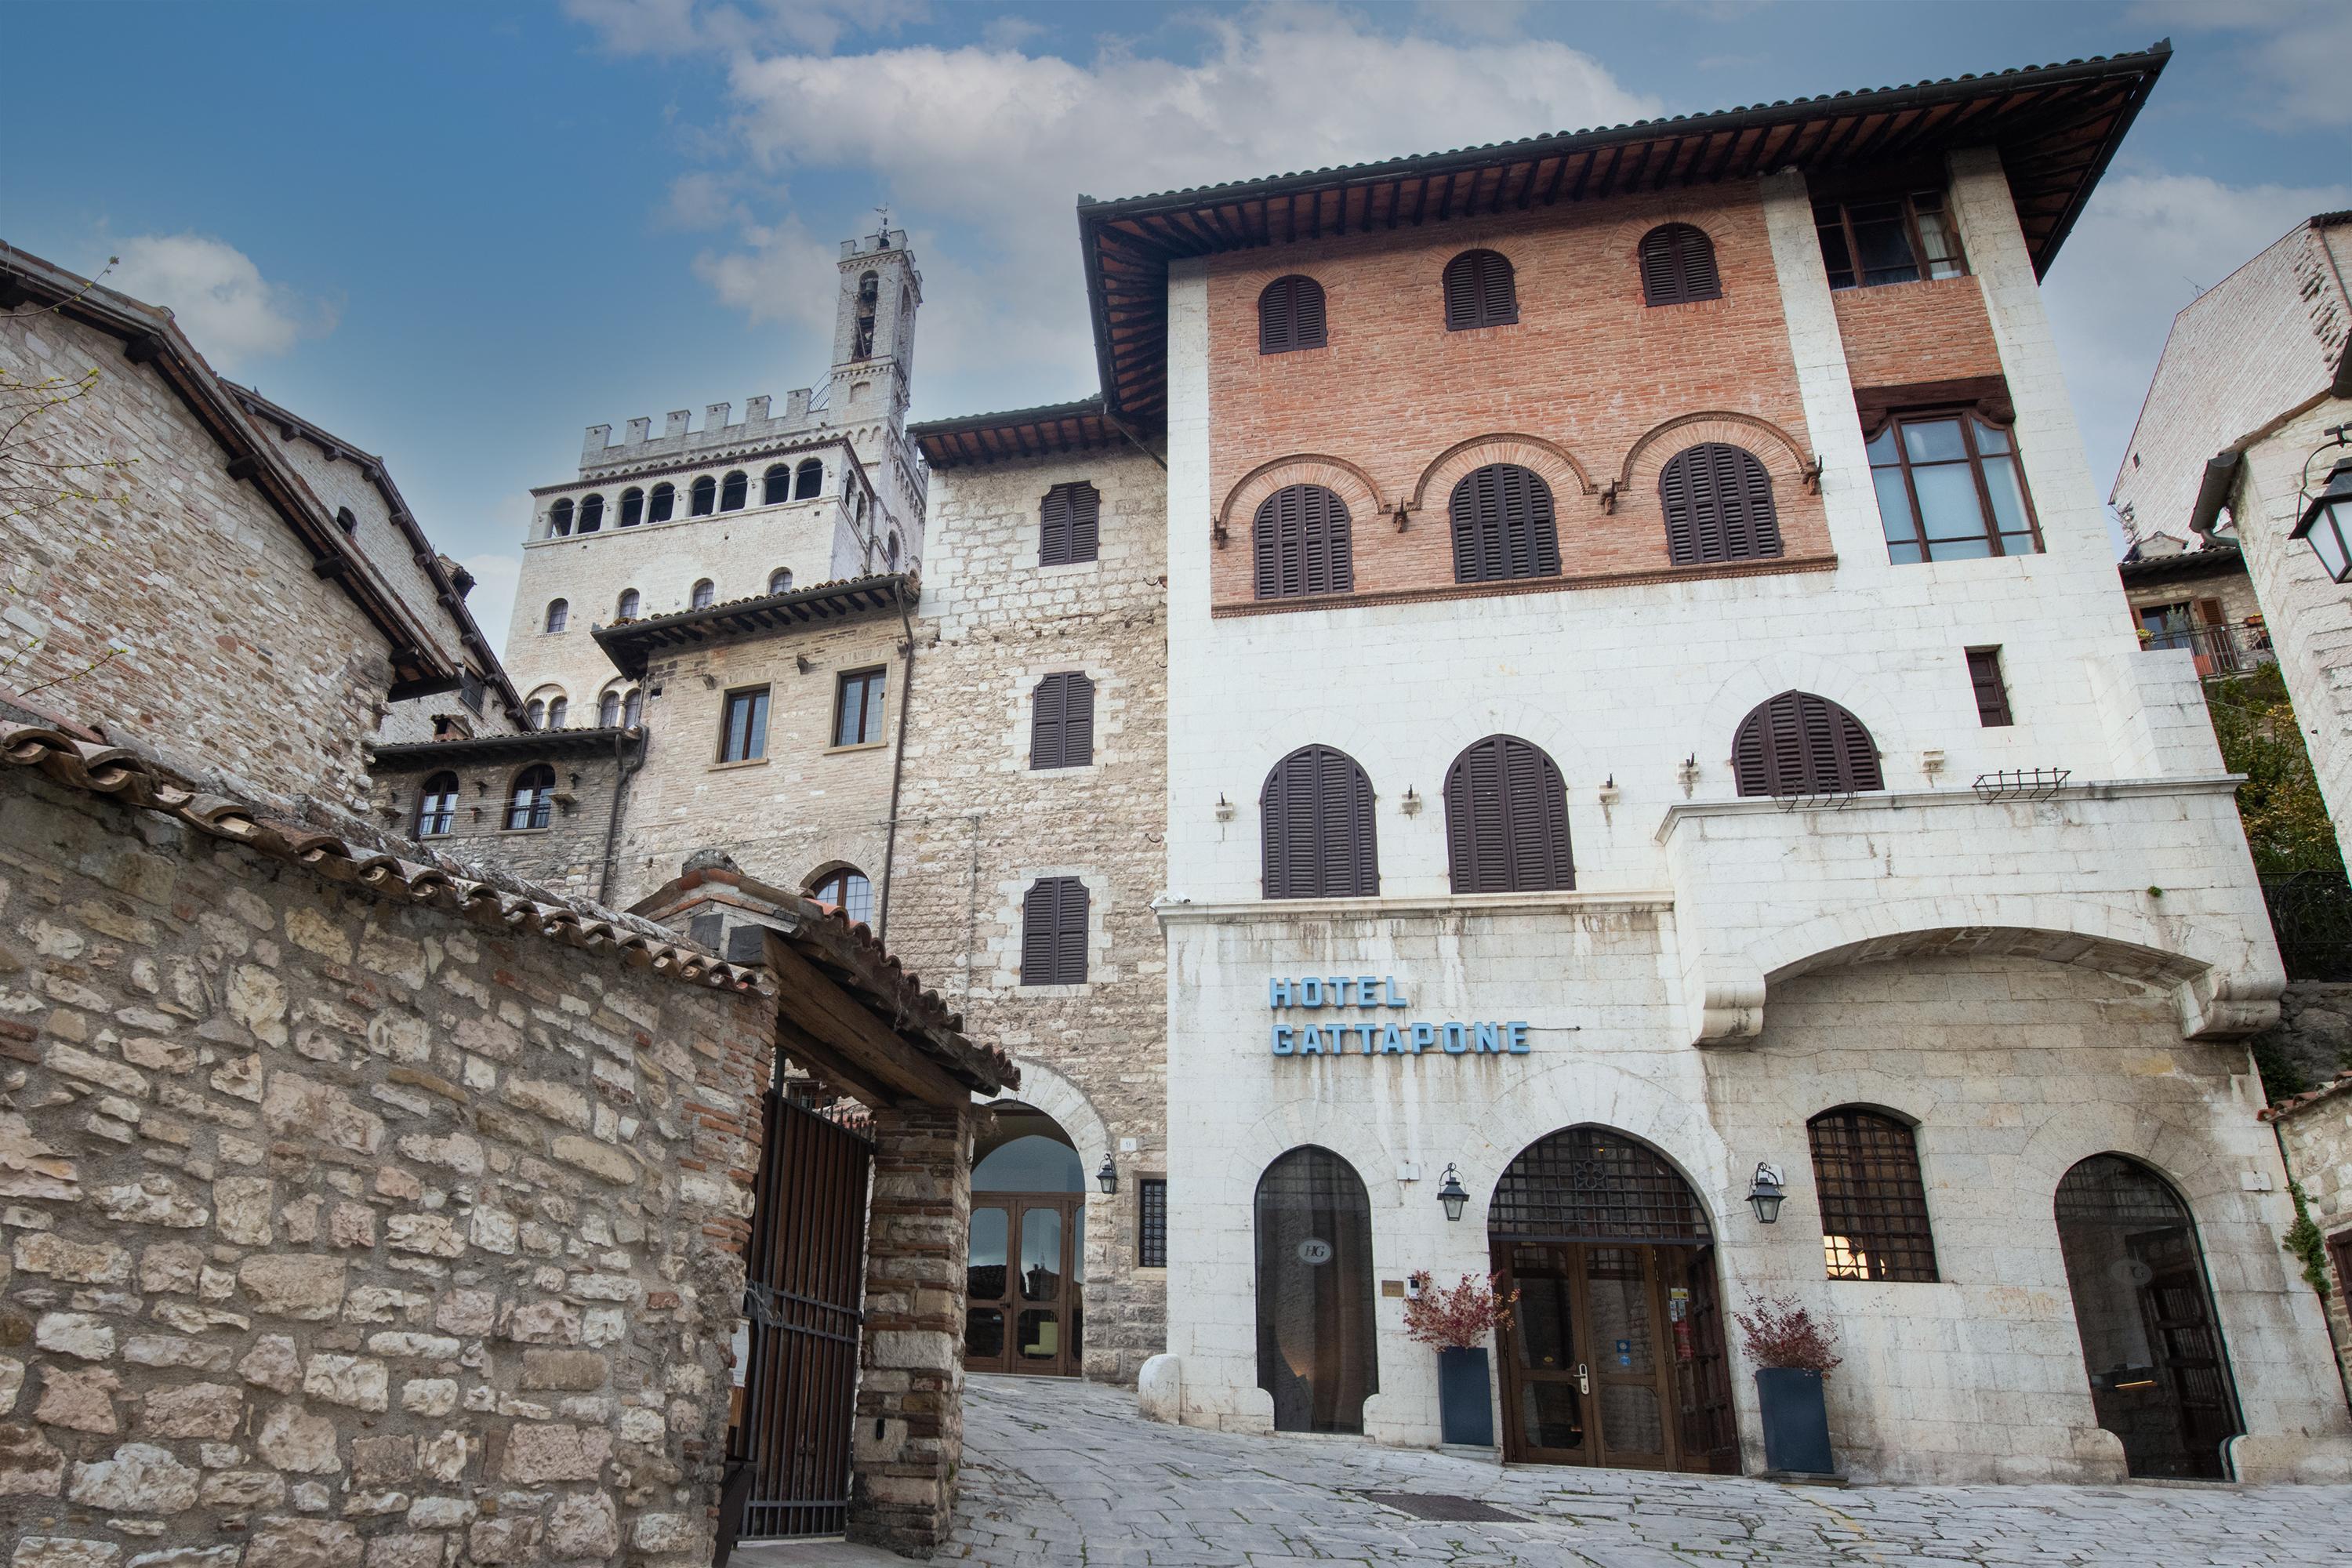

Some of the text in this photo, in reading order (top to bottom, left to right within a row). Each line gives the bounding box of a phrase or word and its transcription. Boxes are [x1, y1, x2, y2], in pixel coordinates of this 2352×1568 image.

[1270, 976, 1406, 1009] HOTEL
[1272, 1021, 1530, 1056] GATTAPONE
[1305, 1245, 1325, 1258] HG
